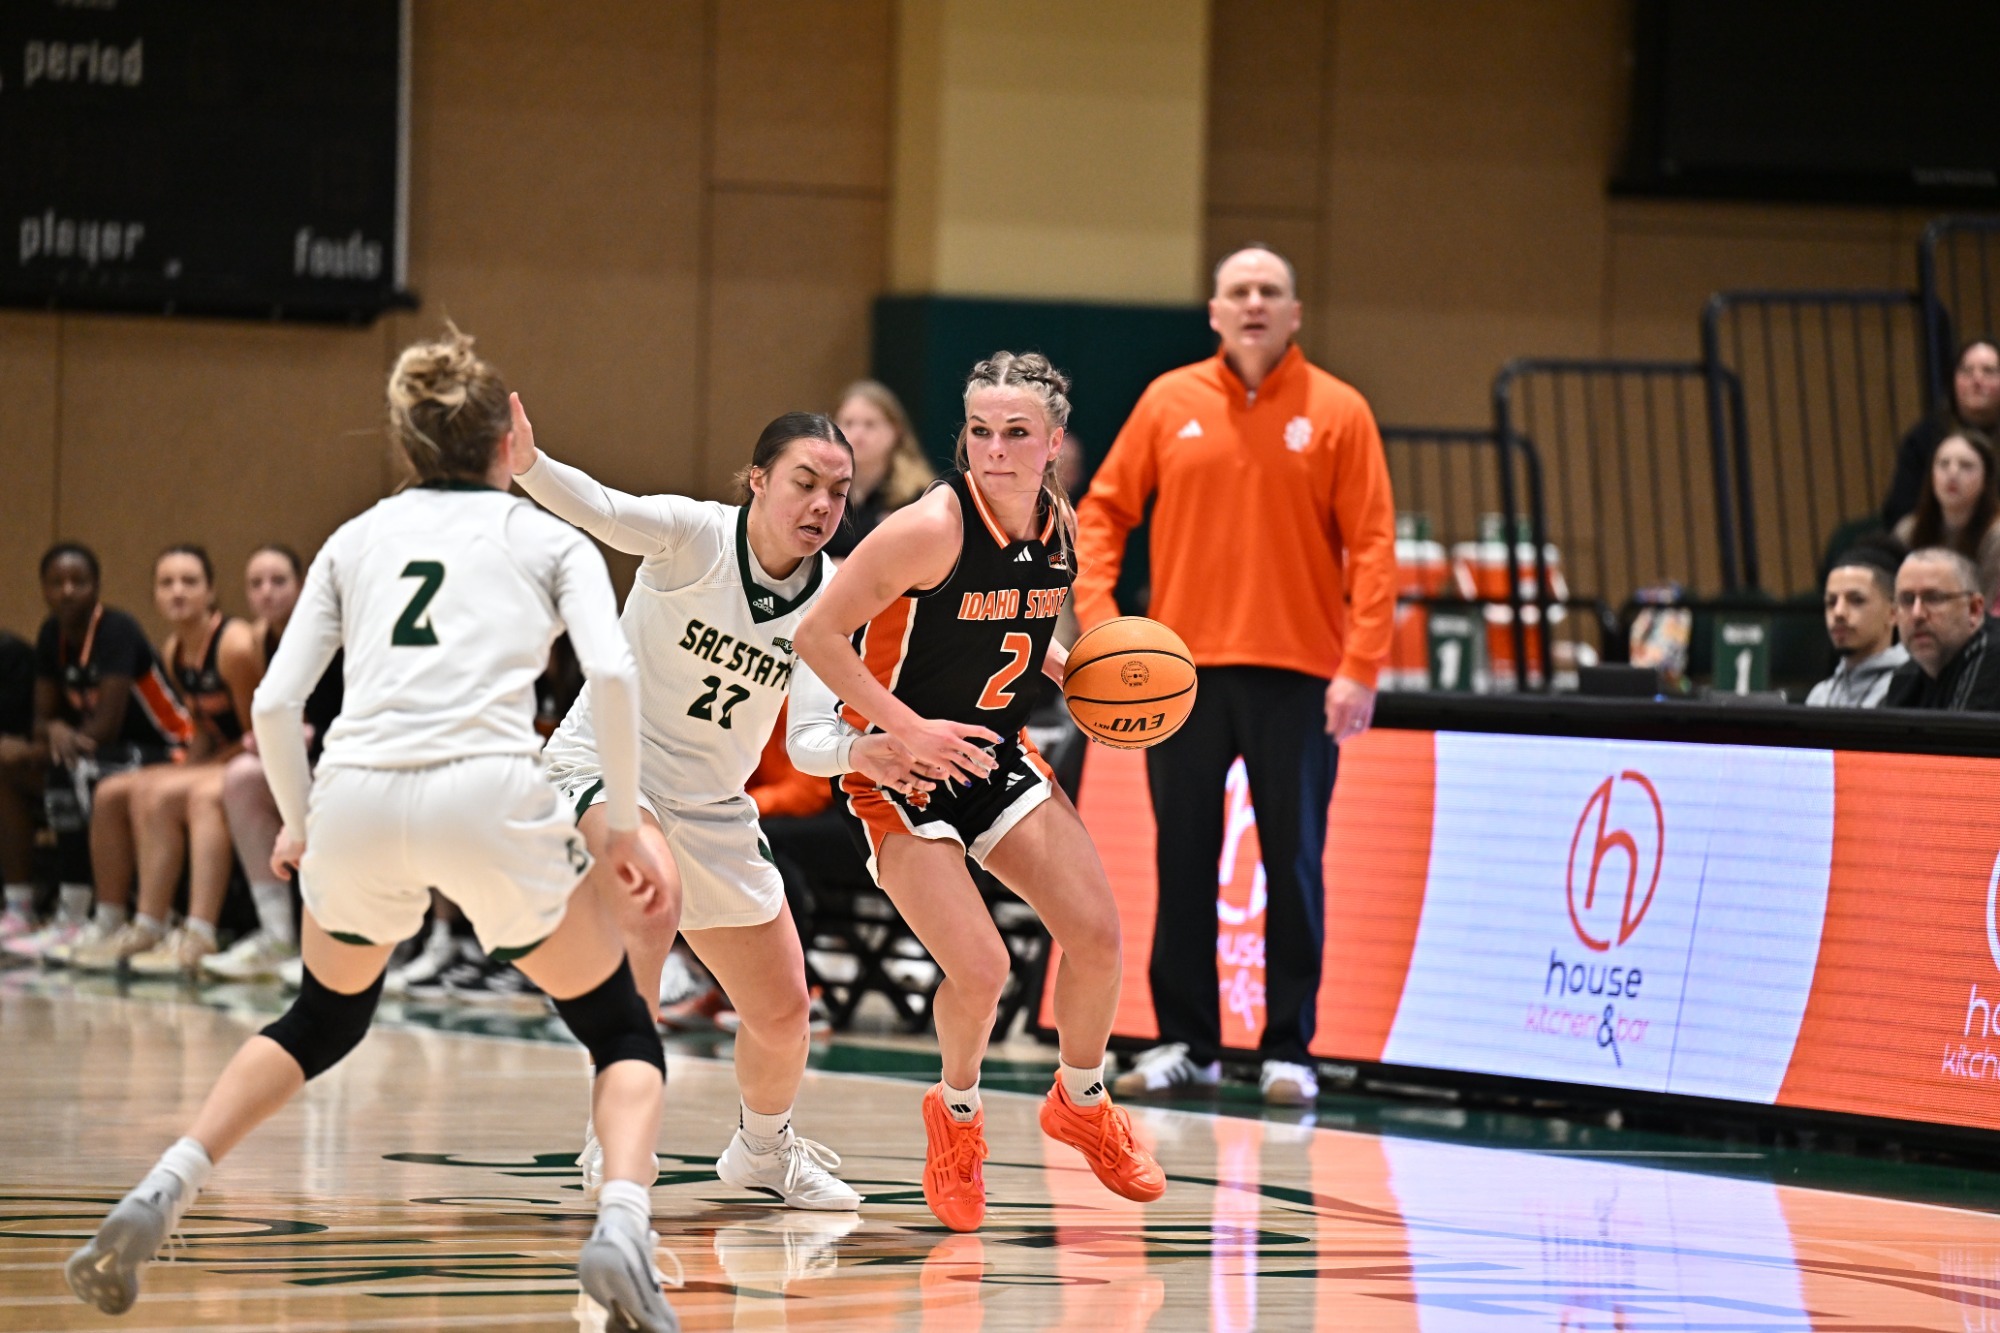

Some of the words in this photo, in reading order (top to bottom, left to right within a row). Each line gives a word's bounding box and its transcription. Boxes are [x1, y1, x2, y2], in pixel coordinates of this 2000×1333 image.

[24, 36, 144, 87] period
[20, 208, 145, 266] player
[294, 226, 383, 280] fouls
[391, 560, 446, 648] 2
[752, 600, 776, 616] adidas
[957, 588, 1021, 621] IDAHO
[975, 631, 1033, 711] 2
[686, 674, 751, 730] 27
[1110, 712, 1166, 733] EVO
[1544, 947, 1643, 998] house
